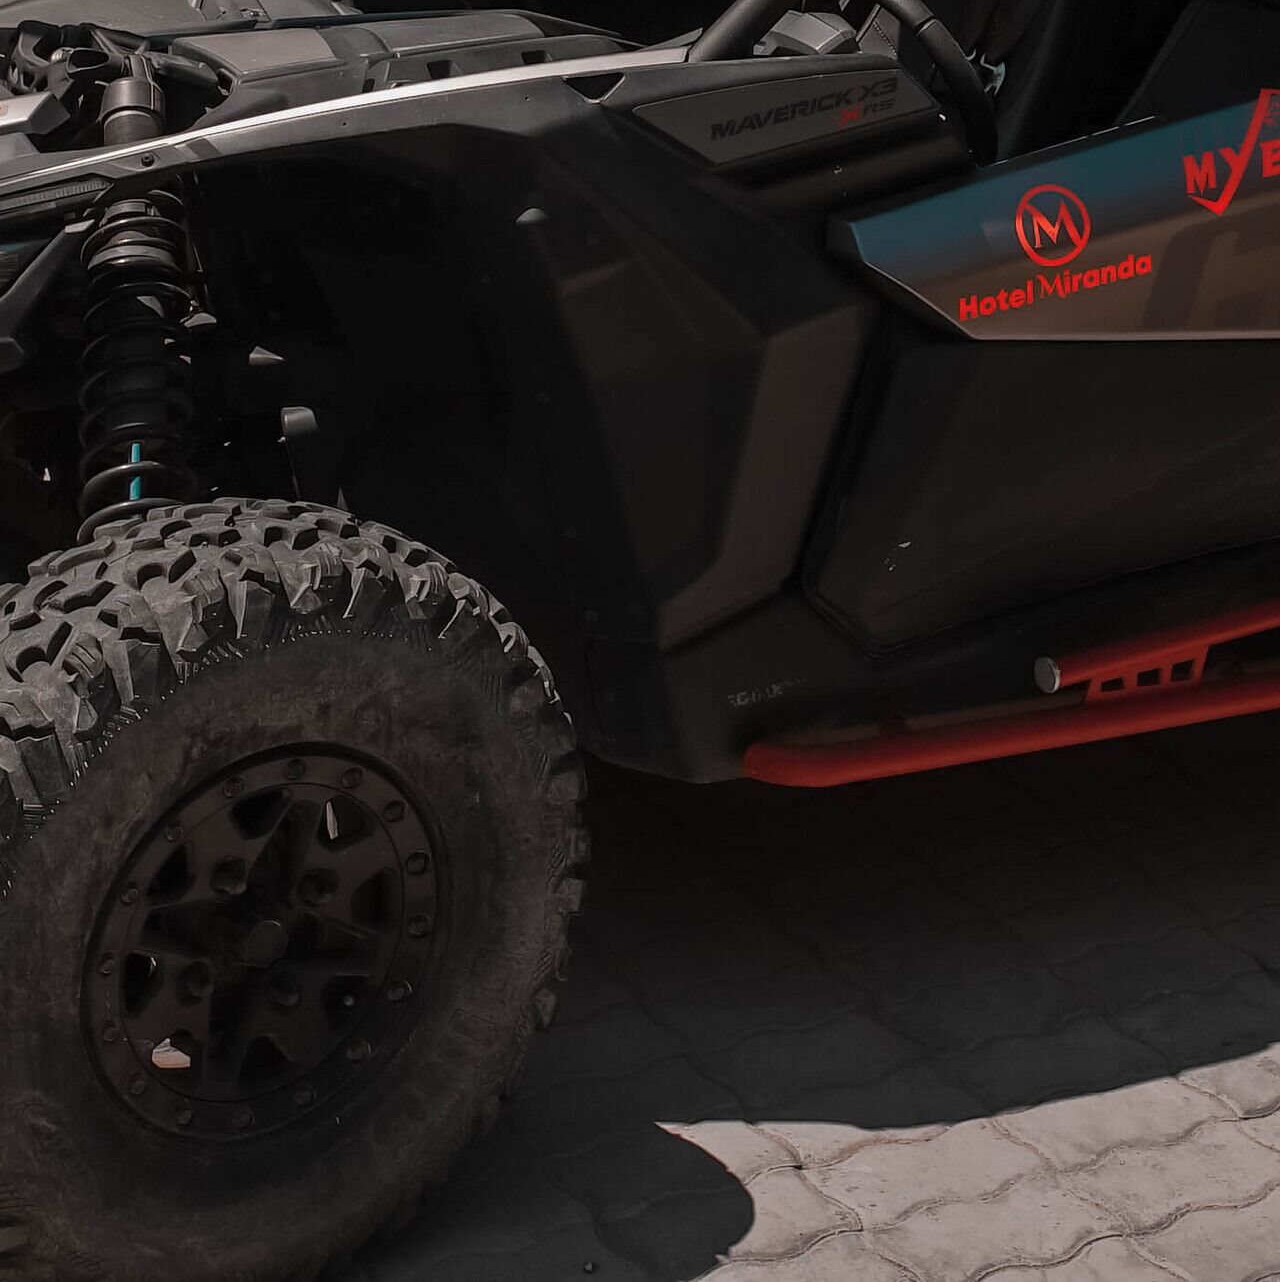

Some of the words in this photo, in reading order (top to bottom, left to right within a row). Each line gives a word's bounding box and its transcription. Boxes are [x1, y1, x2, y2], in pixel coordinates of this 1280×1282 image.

[710, 92, 847, 143] MAVERICK
[959, 278, 1036, 322] Hotel
[1036, 253, 1154, 300] Miranda
